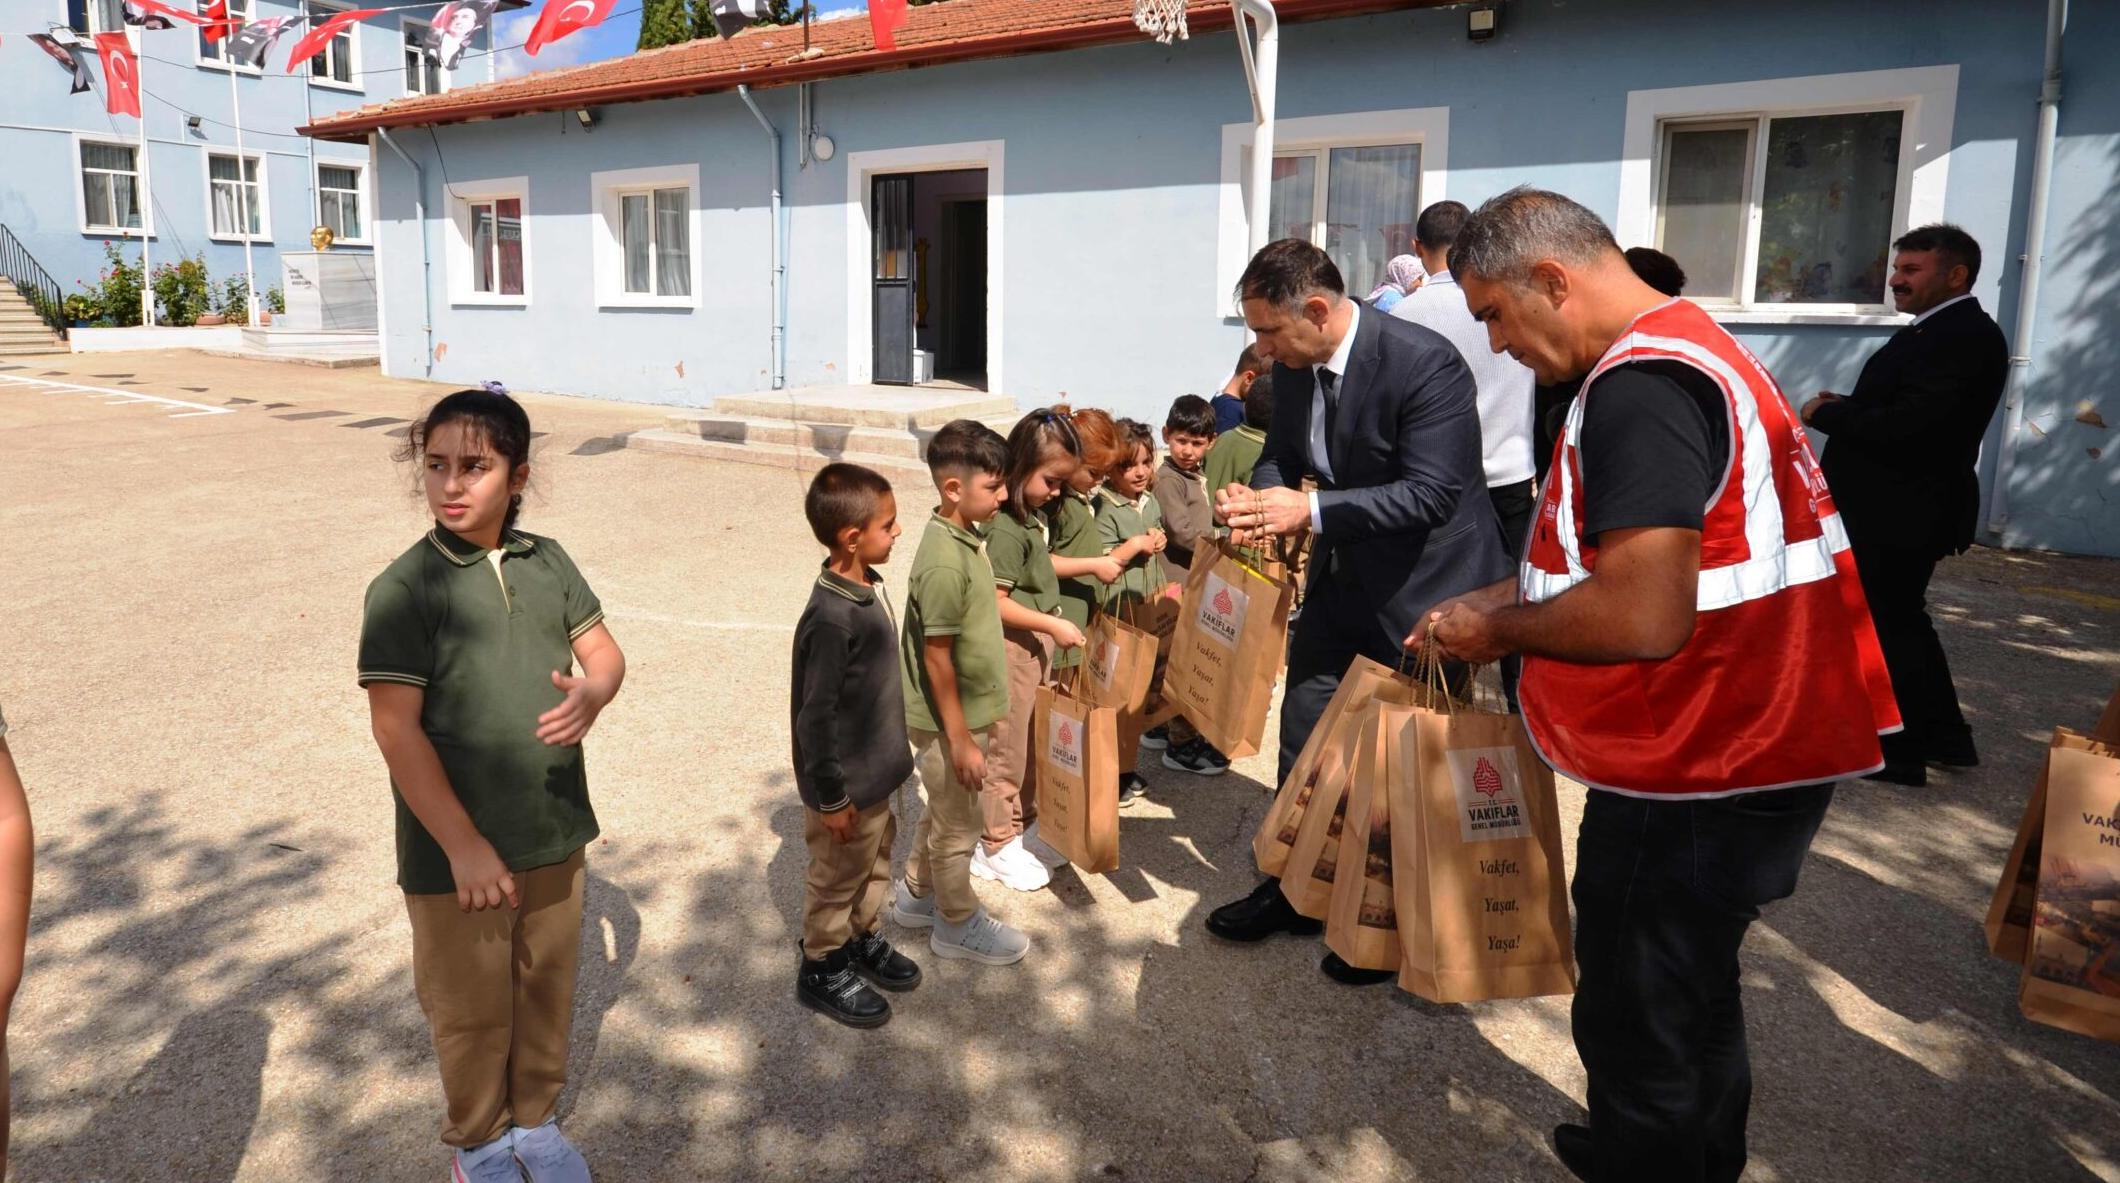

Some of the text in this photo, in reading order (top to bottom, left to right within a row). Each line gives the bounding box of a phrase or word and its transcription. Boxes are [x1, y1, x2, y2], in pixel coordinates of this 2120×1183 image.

[1202, 610, 1235, 637] VAKIFLAR
[1468, 804, 1520, 822] VAKIFLAR
[1479, 858, 1520, 878] Vakfet,
[1484, 897, 1519, 916] Yaşat,
[1488, 934, 1521, 954] Yaşa!
